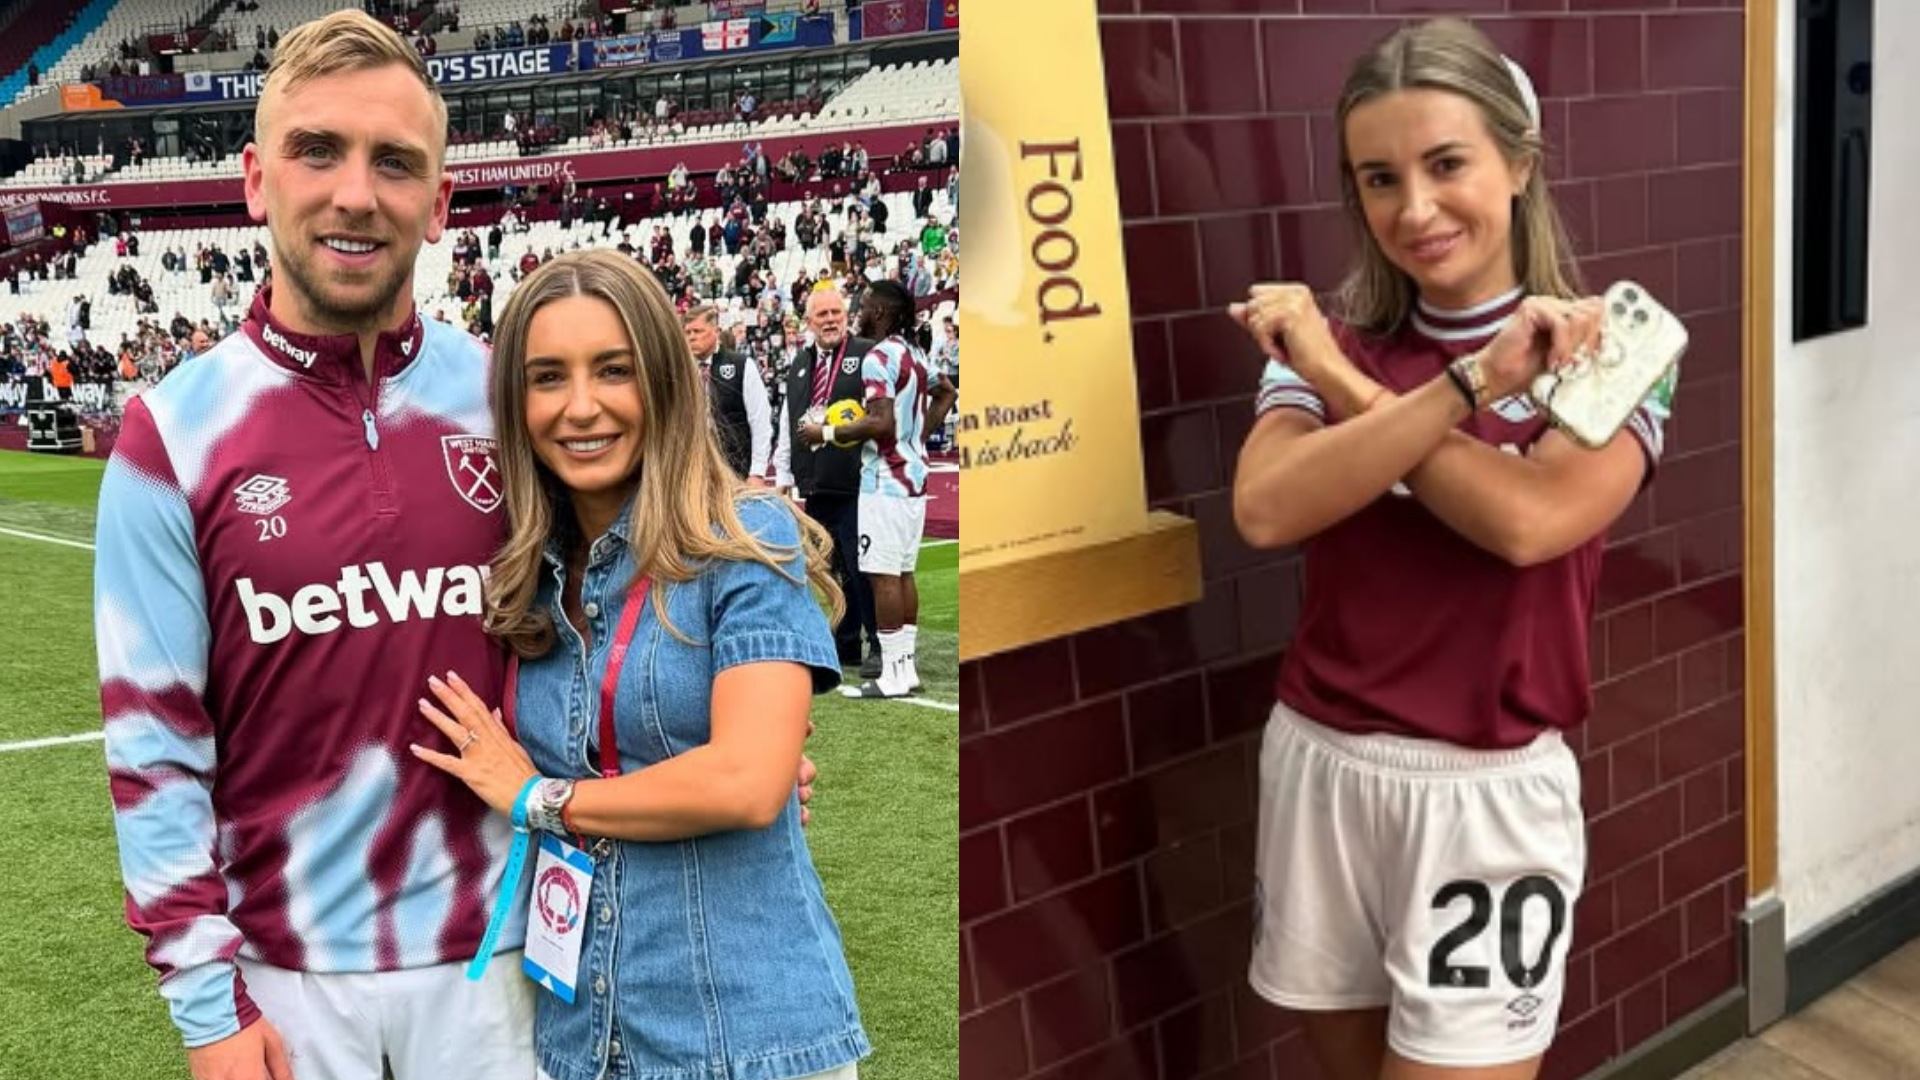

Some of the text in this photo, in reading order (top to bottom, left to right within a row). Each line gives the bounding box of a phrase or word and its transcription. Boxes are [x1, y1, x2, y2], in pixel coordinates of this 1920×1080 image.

[470, 48, 551, 80] STAGE
[481, 166, 508, 182] HAM
[510, 163, 552, 180] UNITED
[1021, 137, 1102, 343] Food.
[262, 322, 317, 368] betway
[958, 399, 1052, 433] n Roast
[975, 439, 1000, 466] is
[254, 515, 287, 542] 20
[235, 561, 490, 644] betwa
[1429, 875, 1566, 988] 20
